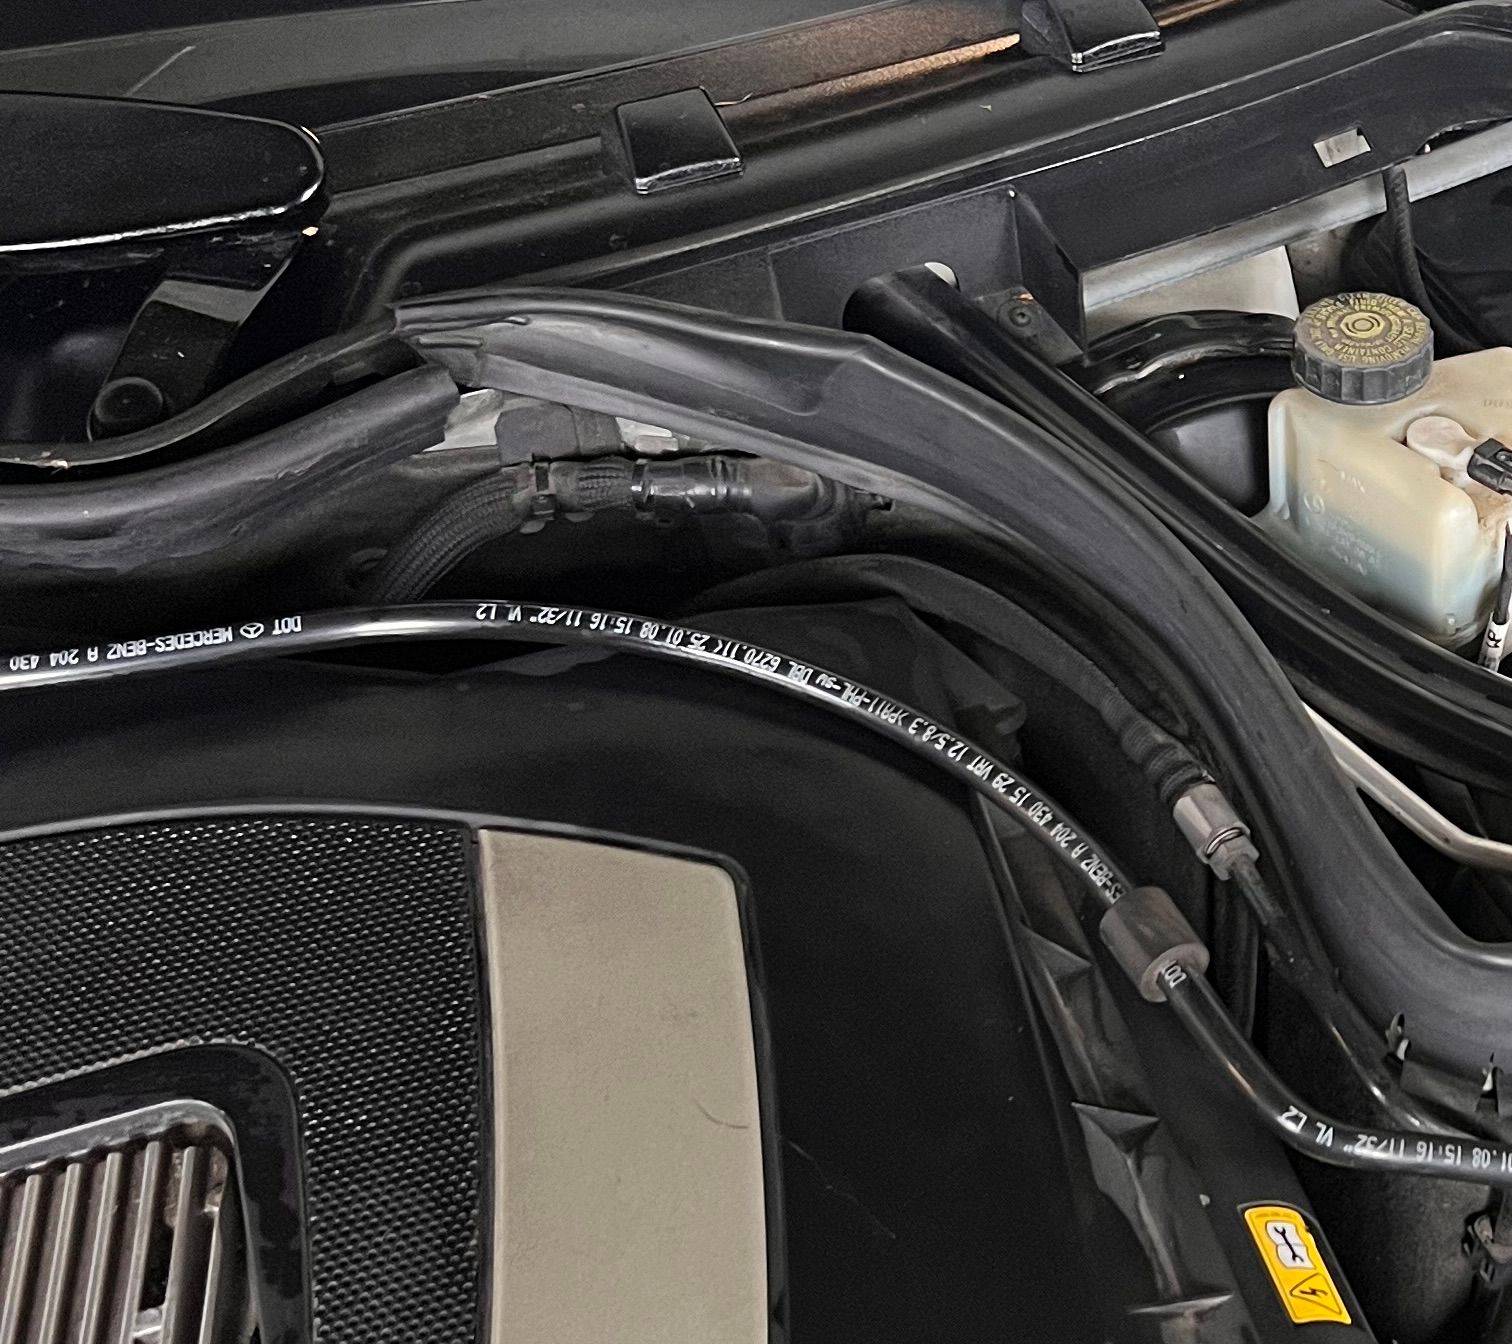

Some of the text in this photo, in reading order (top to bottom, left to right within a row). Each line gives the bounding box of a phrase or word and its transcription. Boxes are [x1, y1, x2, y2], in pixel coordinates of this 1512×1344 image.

[476, 603, 497, 620] L2
[590, 613, 633, 635] 15:16
[10, 616, 301, 671] DOT MERCEDES-BENZ A 204 430
[640, 621, 710, 651] 25.01.08
[789, 661, 814, 684] DBL
[908, 717, 969, 761] 12.5/8.3
[966, 755, 994, 781] VRT
[991, 773, 1015, 793] 29
[1009, 786, 1032, 806] 15
[1028, 801, 1053, 826] 430
[1050, 822, 1077, 848] 204
[1071, 843, 1089, 859] A
[1277, 1105, 1307, 1133] L2
[1315, 1121, 1333, 1147] VL
[1416, 1141, 1462, 1166] 15:16
